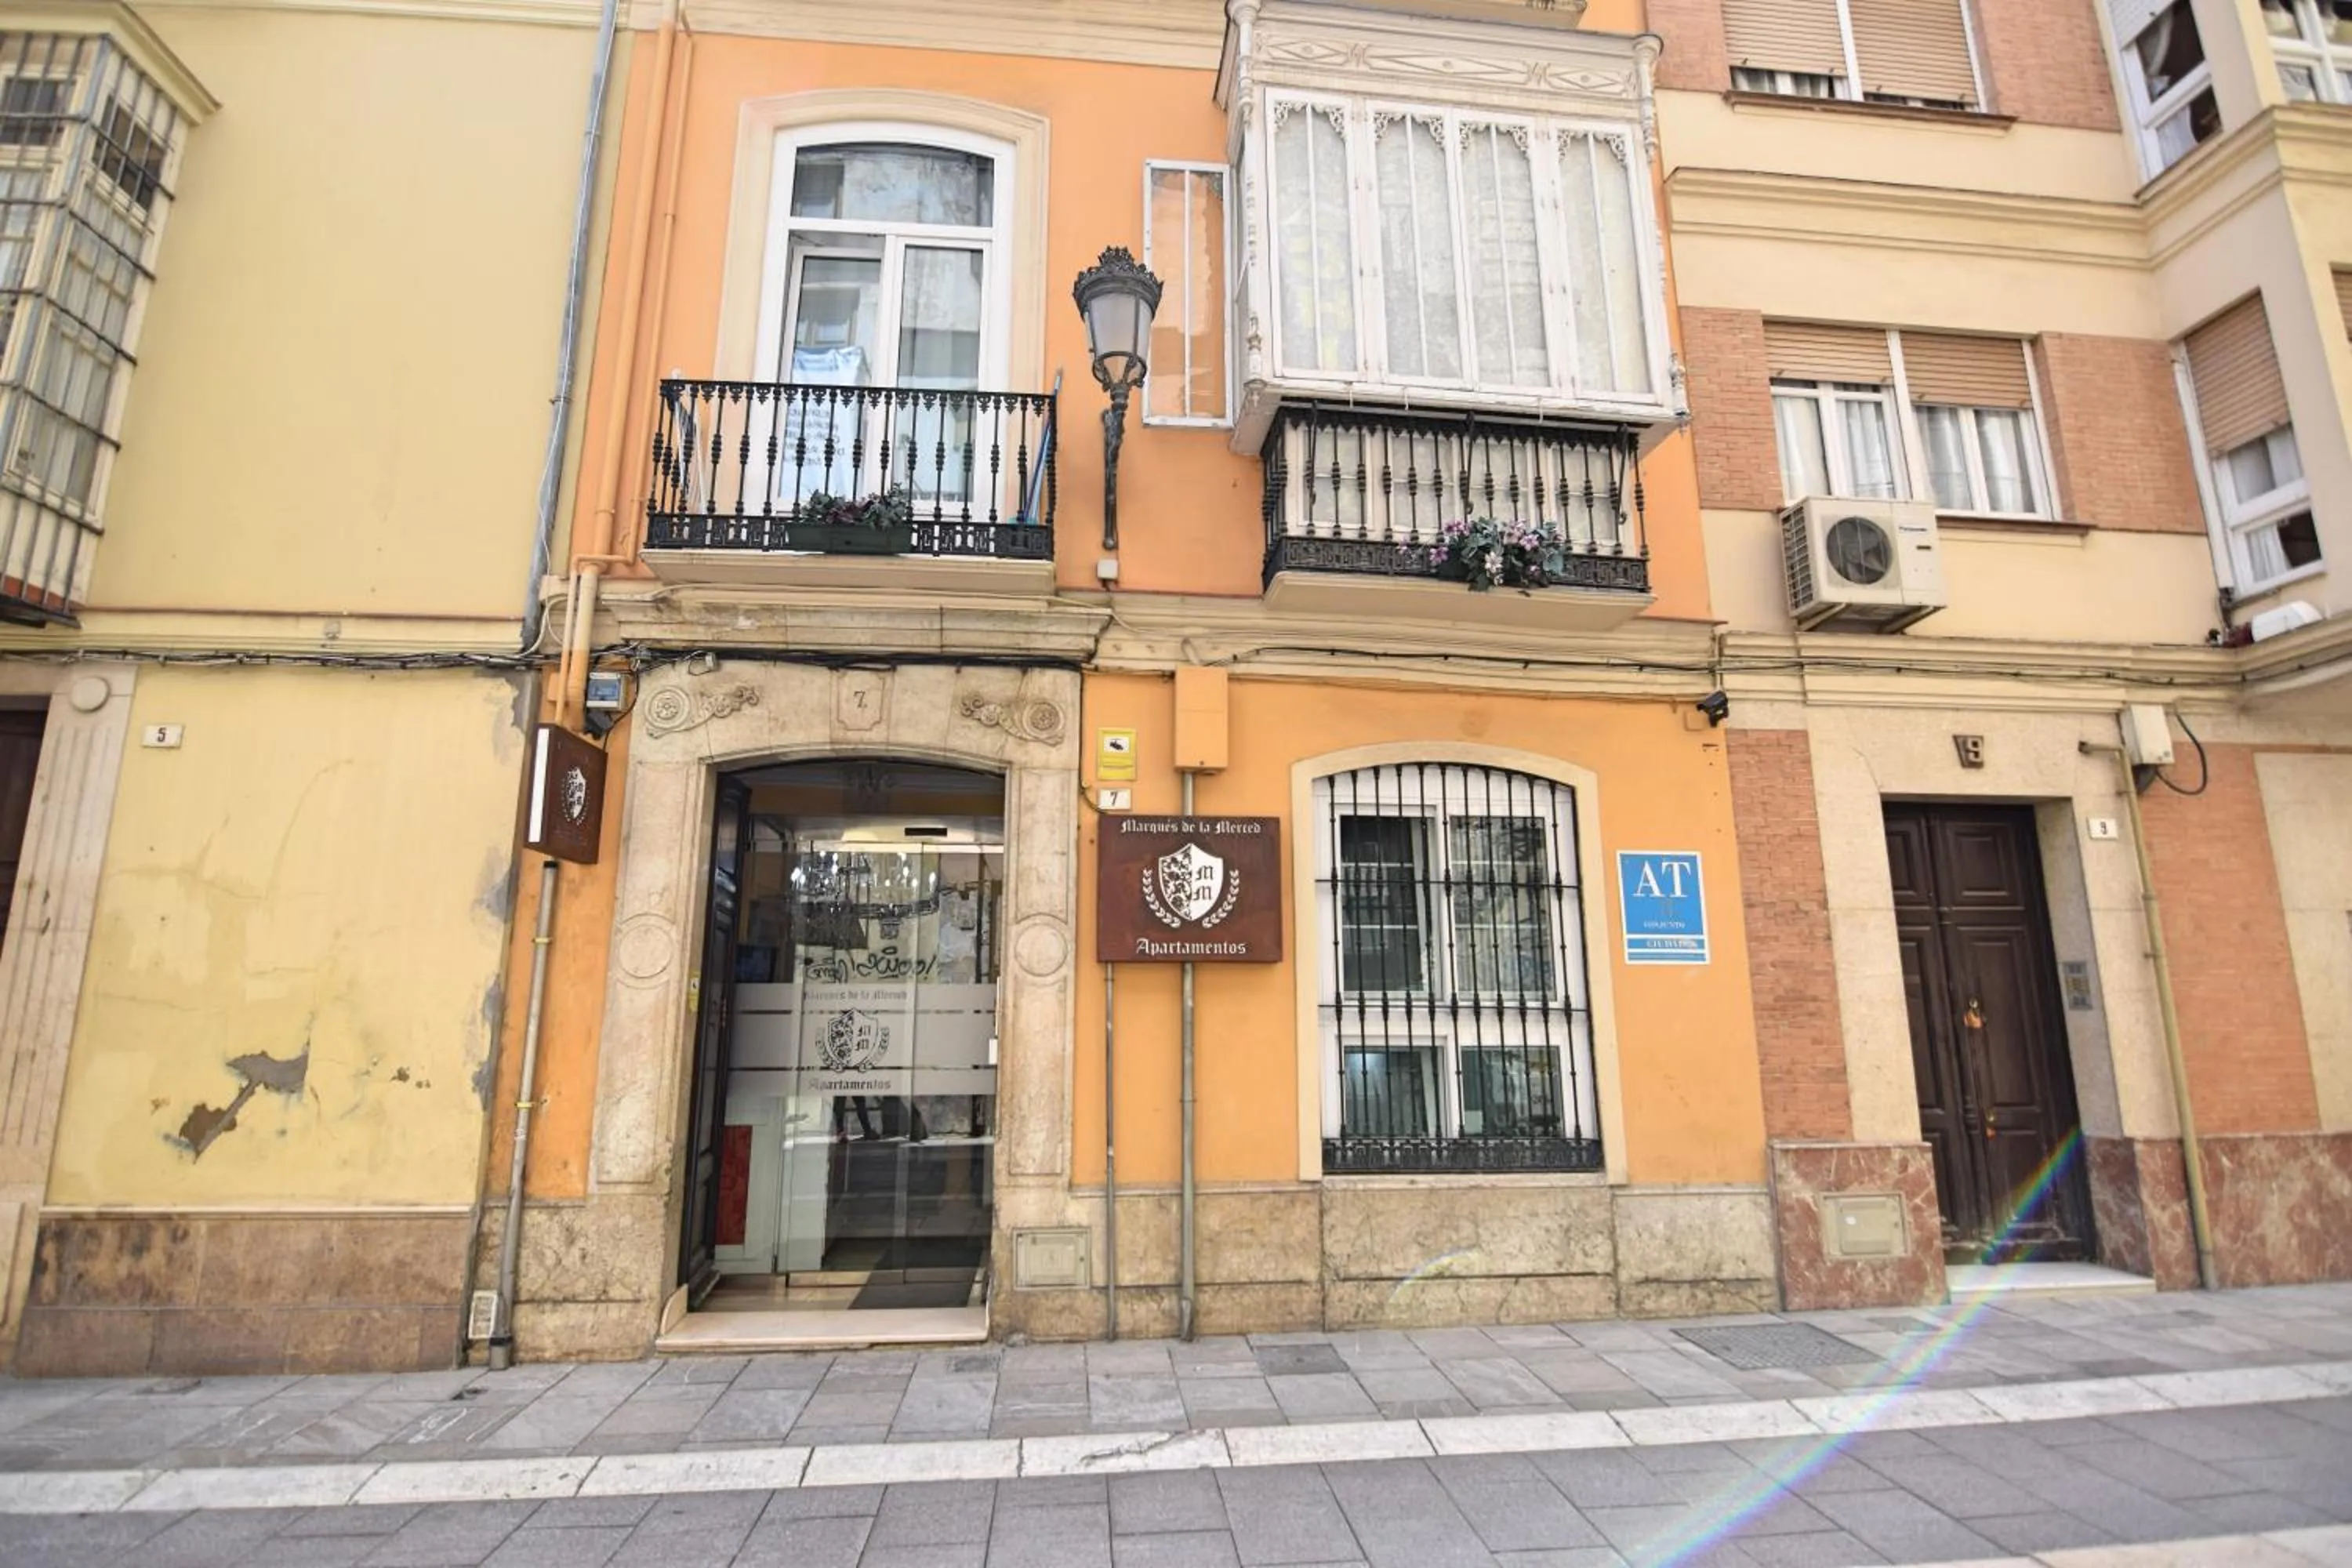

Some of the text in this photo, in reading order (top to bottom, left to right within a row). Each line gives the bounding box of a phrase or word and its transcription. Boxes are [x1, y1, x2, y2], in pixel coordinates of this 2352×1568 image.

[158, 727, 167, 742] 5
[1109, 791, 1118, 807] 7
[1120, 818, 1261, 834] Marqués de la Merced
[1195, 865, 1214, 881] M
[1632, 860, 1691, 898] AT
[1193, 885, 1211, 901] M
[1137, 938, 1247, 956] Apartamentos
